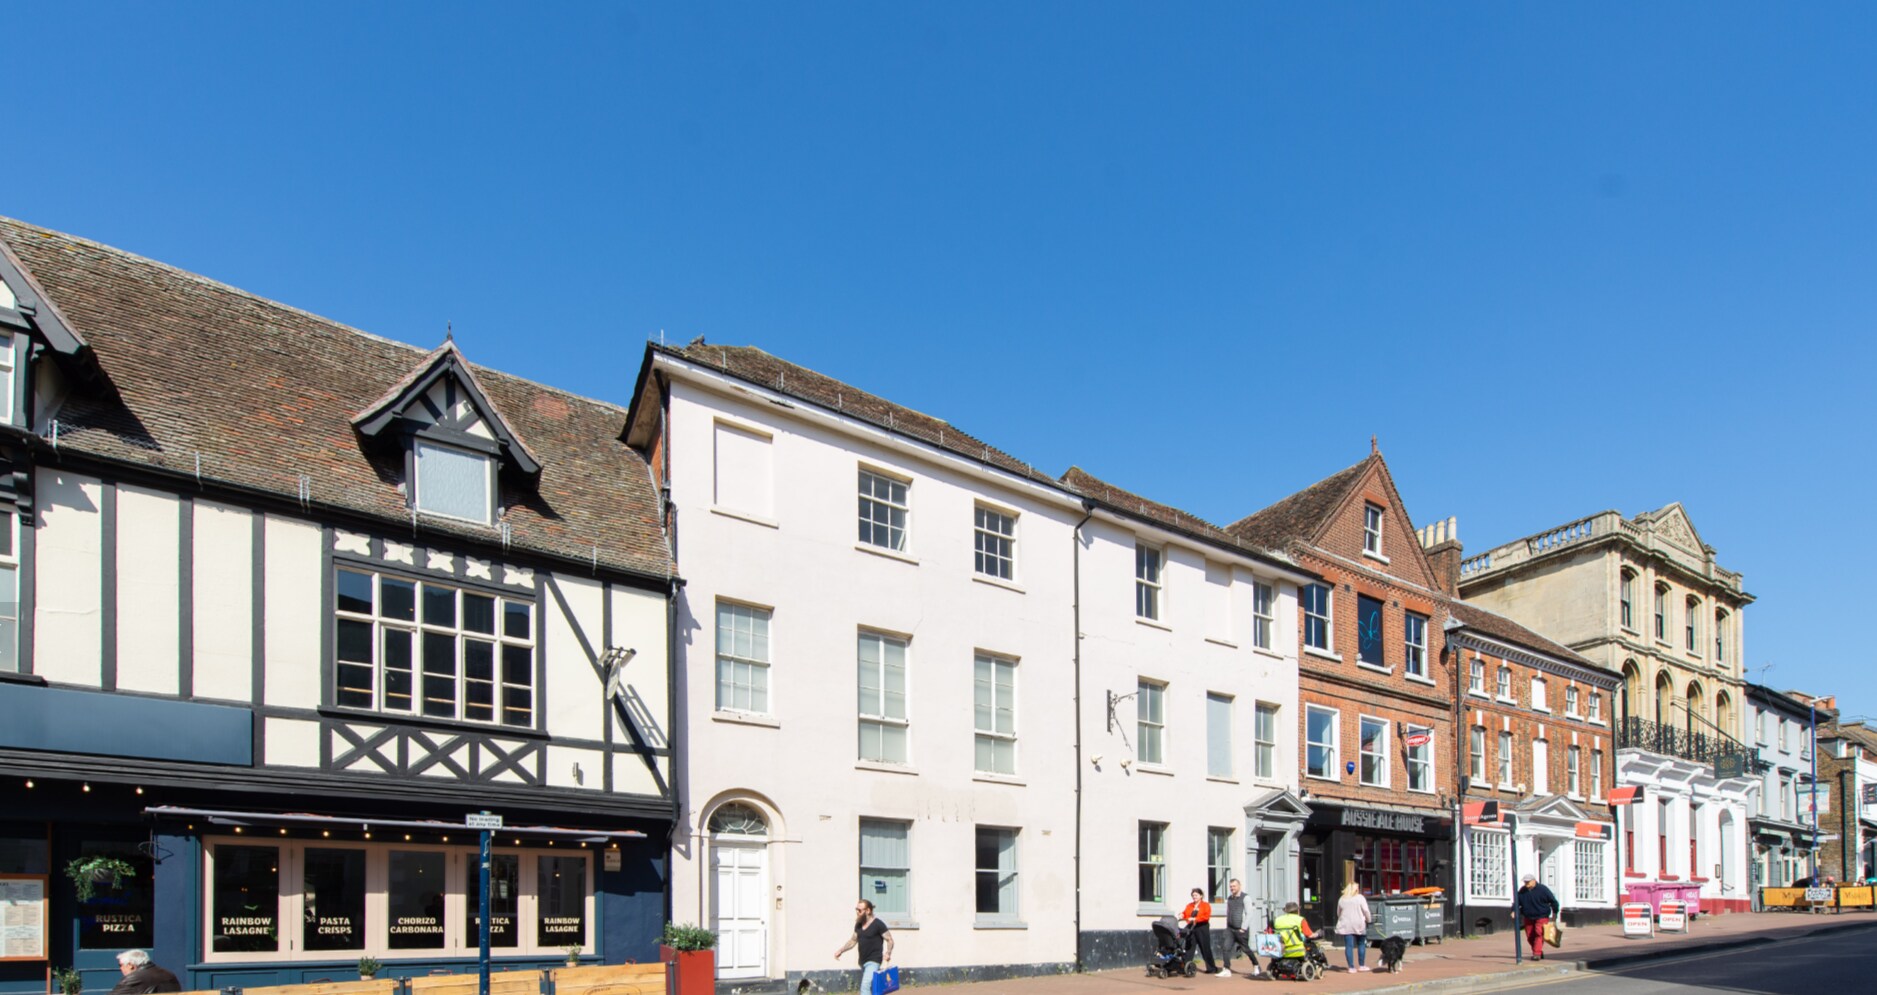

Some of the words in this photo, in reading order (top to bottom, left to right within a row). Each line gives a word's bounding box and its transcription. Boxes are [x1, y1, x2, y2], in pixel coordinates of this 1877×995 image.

[1342, 808, 1377, 828] AUSSIE
[1377, 811, 1395, 830] ALE
[1395, 813, 1425, 833] HOUSE
[96, 914, 142, 923] RUSTICA
[222, 917, 271, 926] RAINBOW
[320, 917, 351, 925] PASTA
[397, 917, 436, 925] CHORIZO
[474, 917, 510, 925] RTICA
[544, 917, 580, 925] RAINBOW
[102, 923, 135, 932] PIZZA
[223, 926, 269, 935] LASAGNE
[317, 926, 352, 934] CRISPS
[389, 926, 444, 934] CARBONARA
[545, 925, 579, 933] LASAGNE
